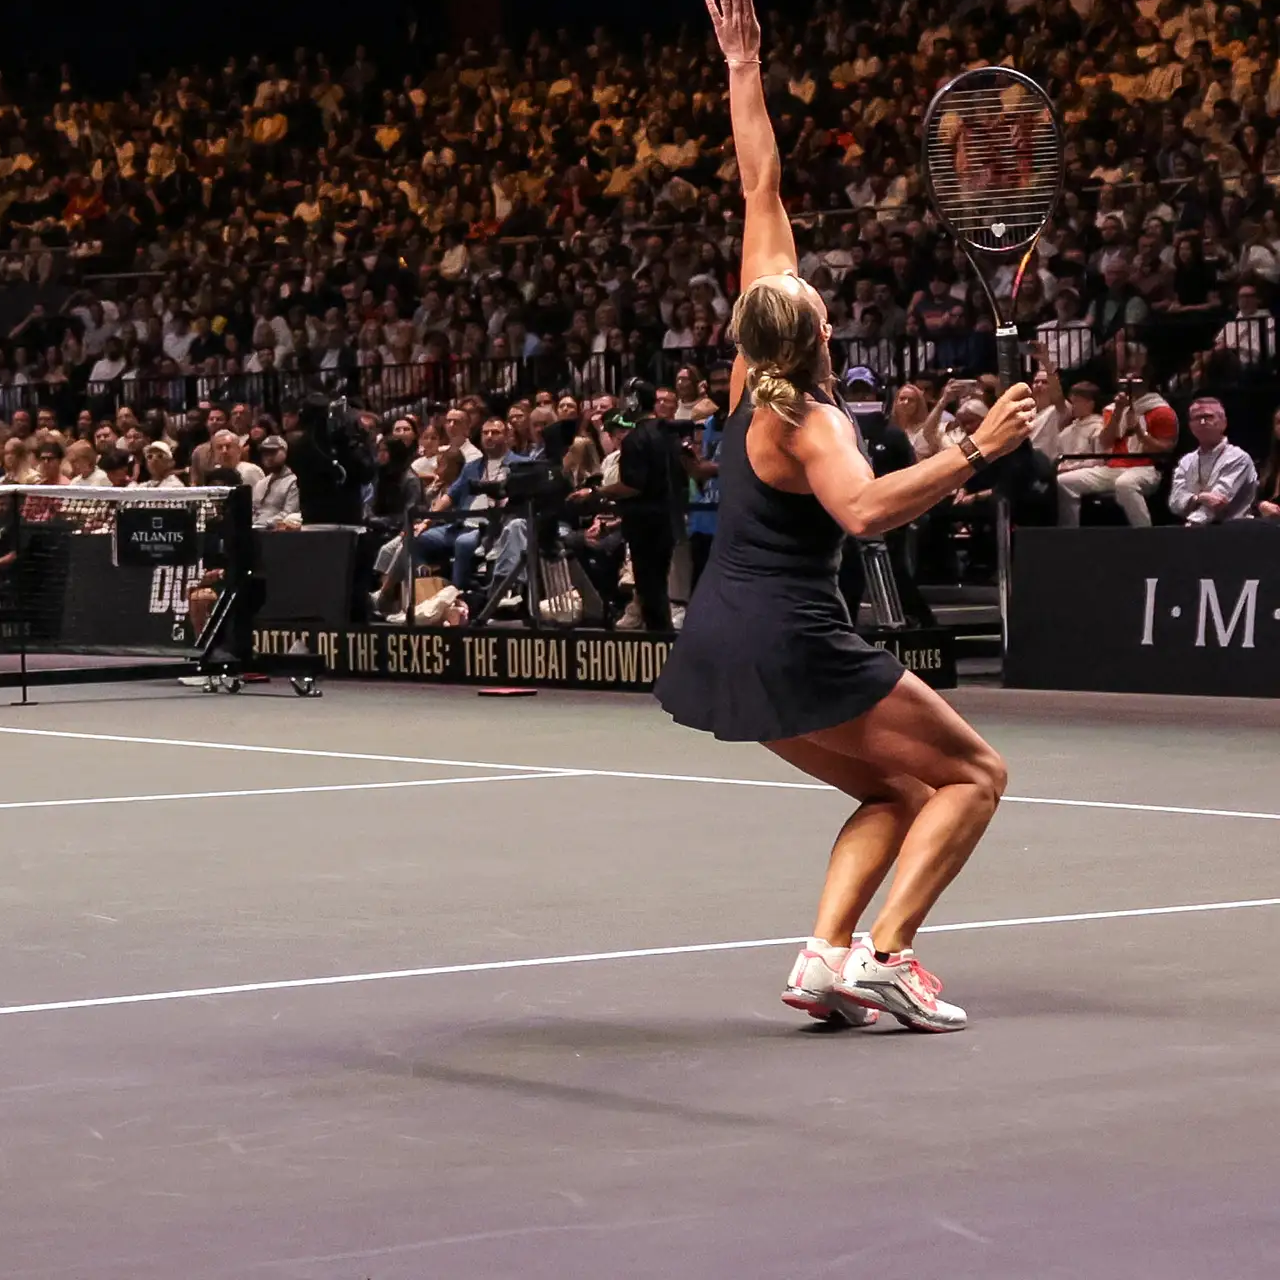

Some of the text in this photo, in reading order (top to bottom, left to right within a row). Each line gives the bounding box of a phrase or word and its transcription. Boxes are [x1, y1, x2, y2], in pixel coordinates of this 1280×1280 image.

[131, 531, 184, 543] ATLANTIS
[347, 633, 378, 671] THE
[387, 634, 450, 674] SEXES:
[463, 637, 497, 677] THE
[507, 638, 567, 681] DUBAI
[576, 640, 673, 683] SHOWDO
[904, 648, 942, 670] SEXES
